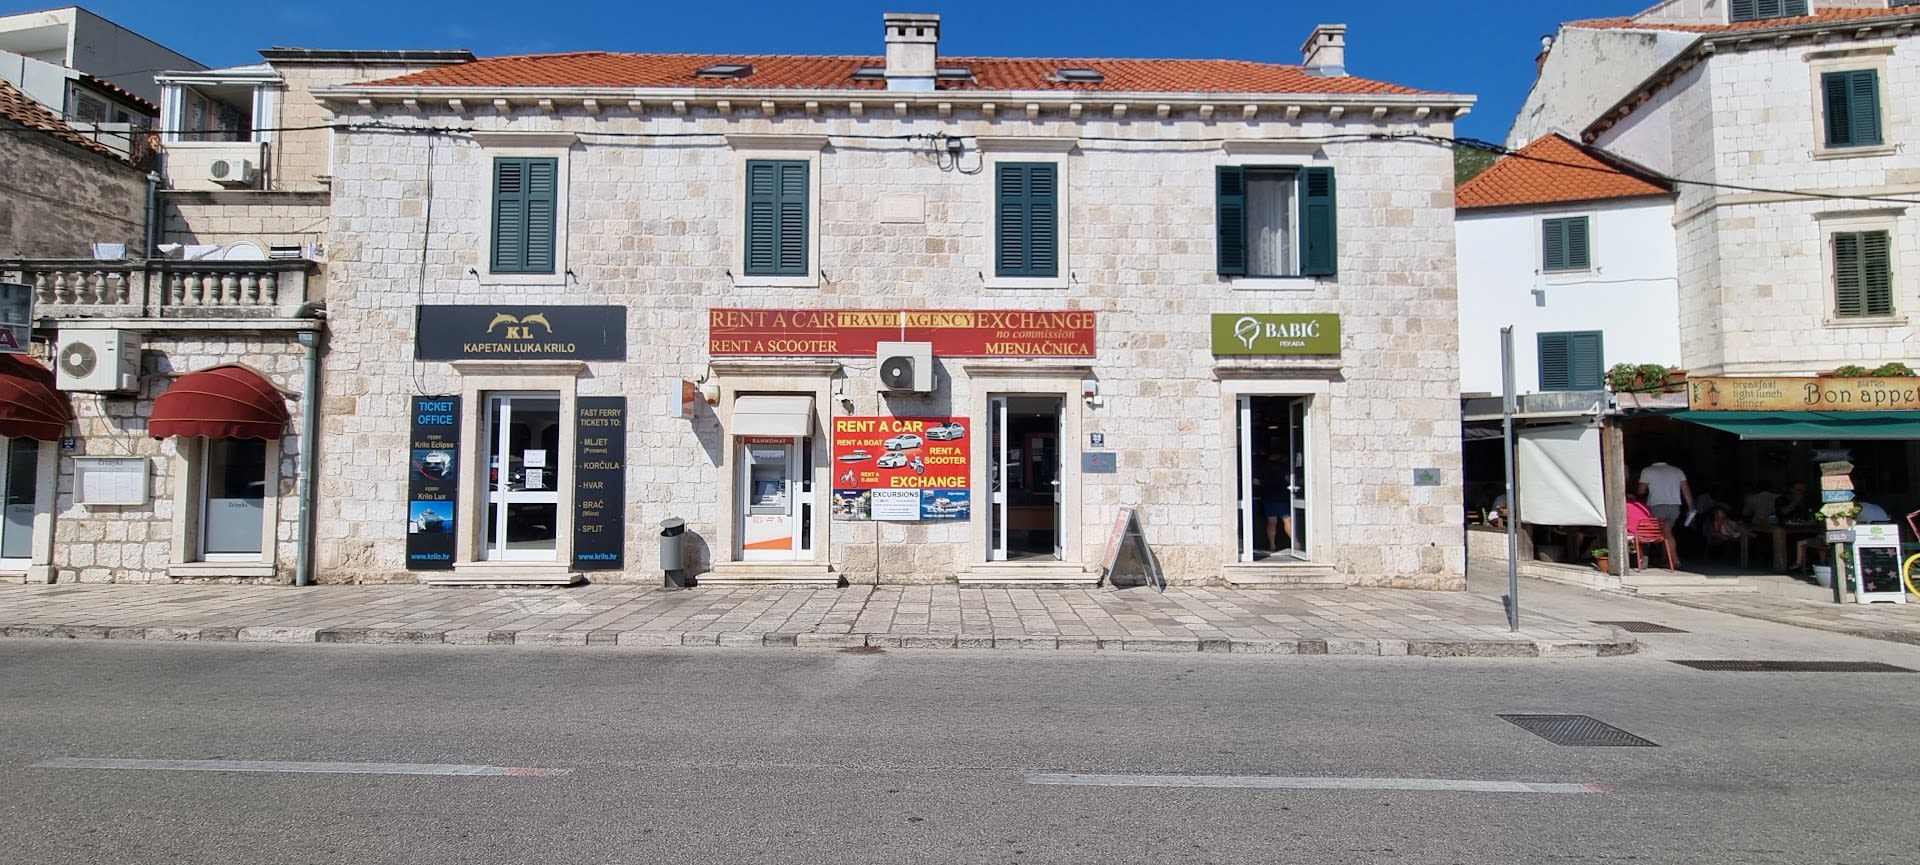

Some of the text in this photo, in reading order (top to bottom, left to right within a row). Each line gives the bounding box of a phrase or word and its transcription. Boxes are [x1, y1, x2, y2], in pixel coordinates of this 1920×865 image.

[712, 311, 838, 328] RENT A CAR
[838, 314, 974, 327] TRAVEL AGENCY
[976, 312, 1095, 329] EXCHANGE
[505, 326, 534, 339] KL
[996, 329, 1075, 339] no commission
[1265, 320, 1320, 338] BABIĆ
[463, 343, 576, 353] KAPETAN LUKA KRILO
[711, 340, 838, 353] RENT A SCOOTER
[985, 340, 1089, 355] MJENJAČNICA
[1732, 380, 1776, 390] breakfast
[1732, 389, 1783, 401] light lunch
[1804, 382, 1851, 405] Bon
[418, 401, 454, 412] TICKET
[1733, 400, 1764, 408] dinner
[580, 408, 621, 417] FAST FERRY
[417, 414, 453, 425] OFFICE
[580, 418, 622, 427] TICKETS TO:
[837, 420, 923, 432] RENT A CAR
[414, 441, 430, 449] Krilo
[584, 438, 608, 446] MLJET
[929, 447, 961, 455] RENT A
[583, 461, 620, 470] KORČULA
[924, 456, 967, 465] SCOOTER
[583, 481, 604, 489] HVAR
[890, 476, 966, 488] EXCHANGE
[582, 500, 604, 509] BRAČ
[582, 525, 603, 533] SPLIT
